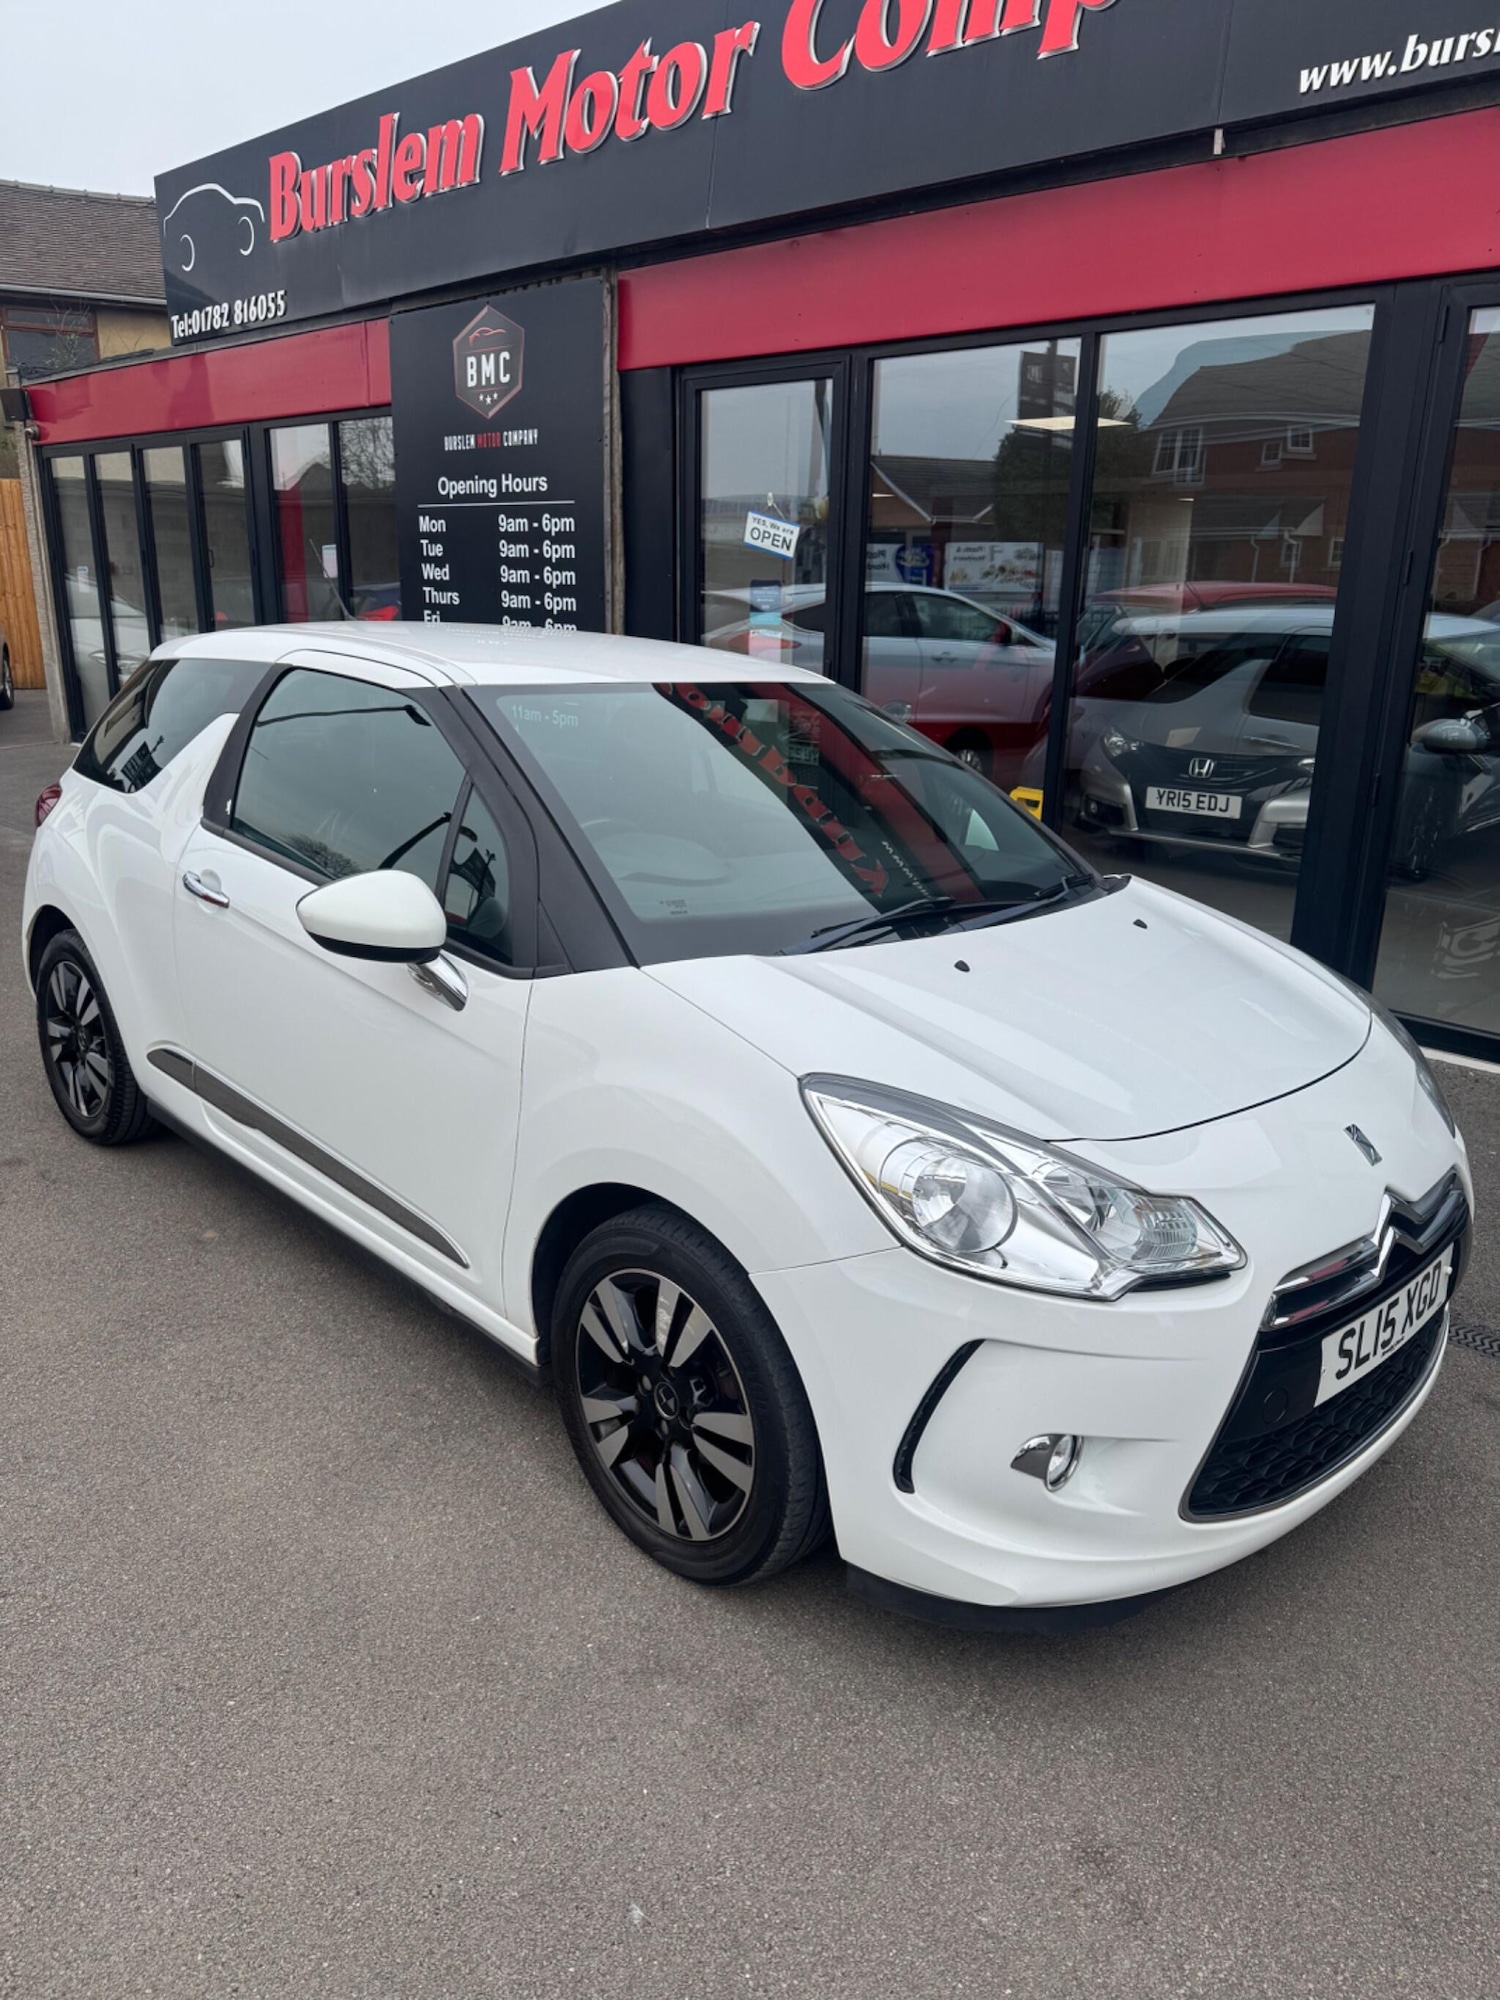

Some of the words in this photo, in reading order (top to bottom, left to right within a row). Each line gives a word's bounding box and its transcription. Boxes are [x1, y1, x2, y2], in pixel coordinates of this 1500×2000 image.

[269, 112, 484, 242] Burslem
[499, 21, 761, 176] Motor
[171, 302, 230, 339] Tel:01782
[233, 289, 286, 325] 816055
[466, 351, 511, 388] BMC
[444, 434, 476, 451] BURSLEM
[477, 432, 501, 449] MOTOR
[502, 429, 538, 447] COMPANY
[438, 475, 497, 499] Opening
[501, 473, 548, 493] Hours
[419, 516, 446, 532] Mon
[498, 514, 528, 532] 9am
[542, 513, 575, 536] 6pm
[420, 539, 443, 557] Tue
[499, 540, 529, 558] 9am
[543, 540, 576, 563] 6pm
[750, 526, 792, 551] OPEN
[421, 563, 450, 580] Wed
[500, 565, 530, 583] 9am
[543, 566, 576, 589] 6pm
[422, 586, 460, 605] Thurs
[501, 590, 531, 609] 9am
[544, 592, 577, 614] 6pm
[511, 705, 541, 722] 11am
[552, 709, 579, 728] 5pm
[1157, 789, 1192, 808] YR15
[1196, 794, 1230, 813] EDJ
[1335, 1296, 1400, 1380] SL15
[1401, 1260, 1442, 1335] XGD
